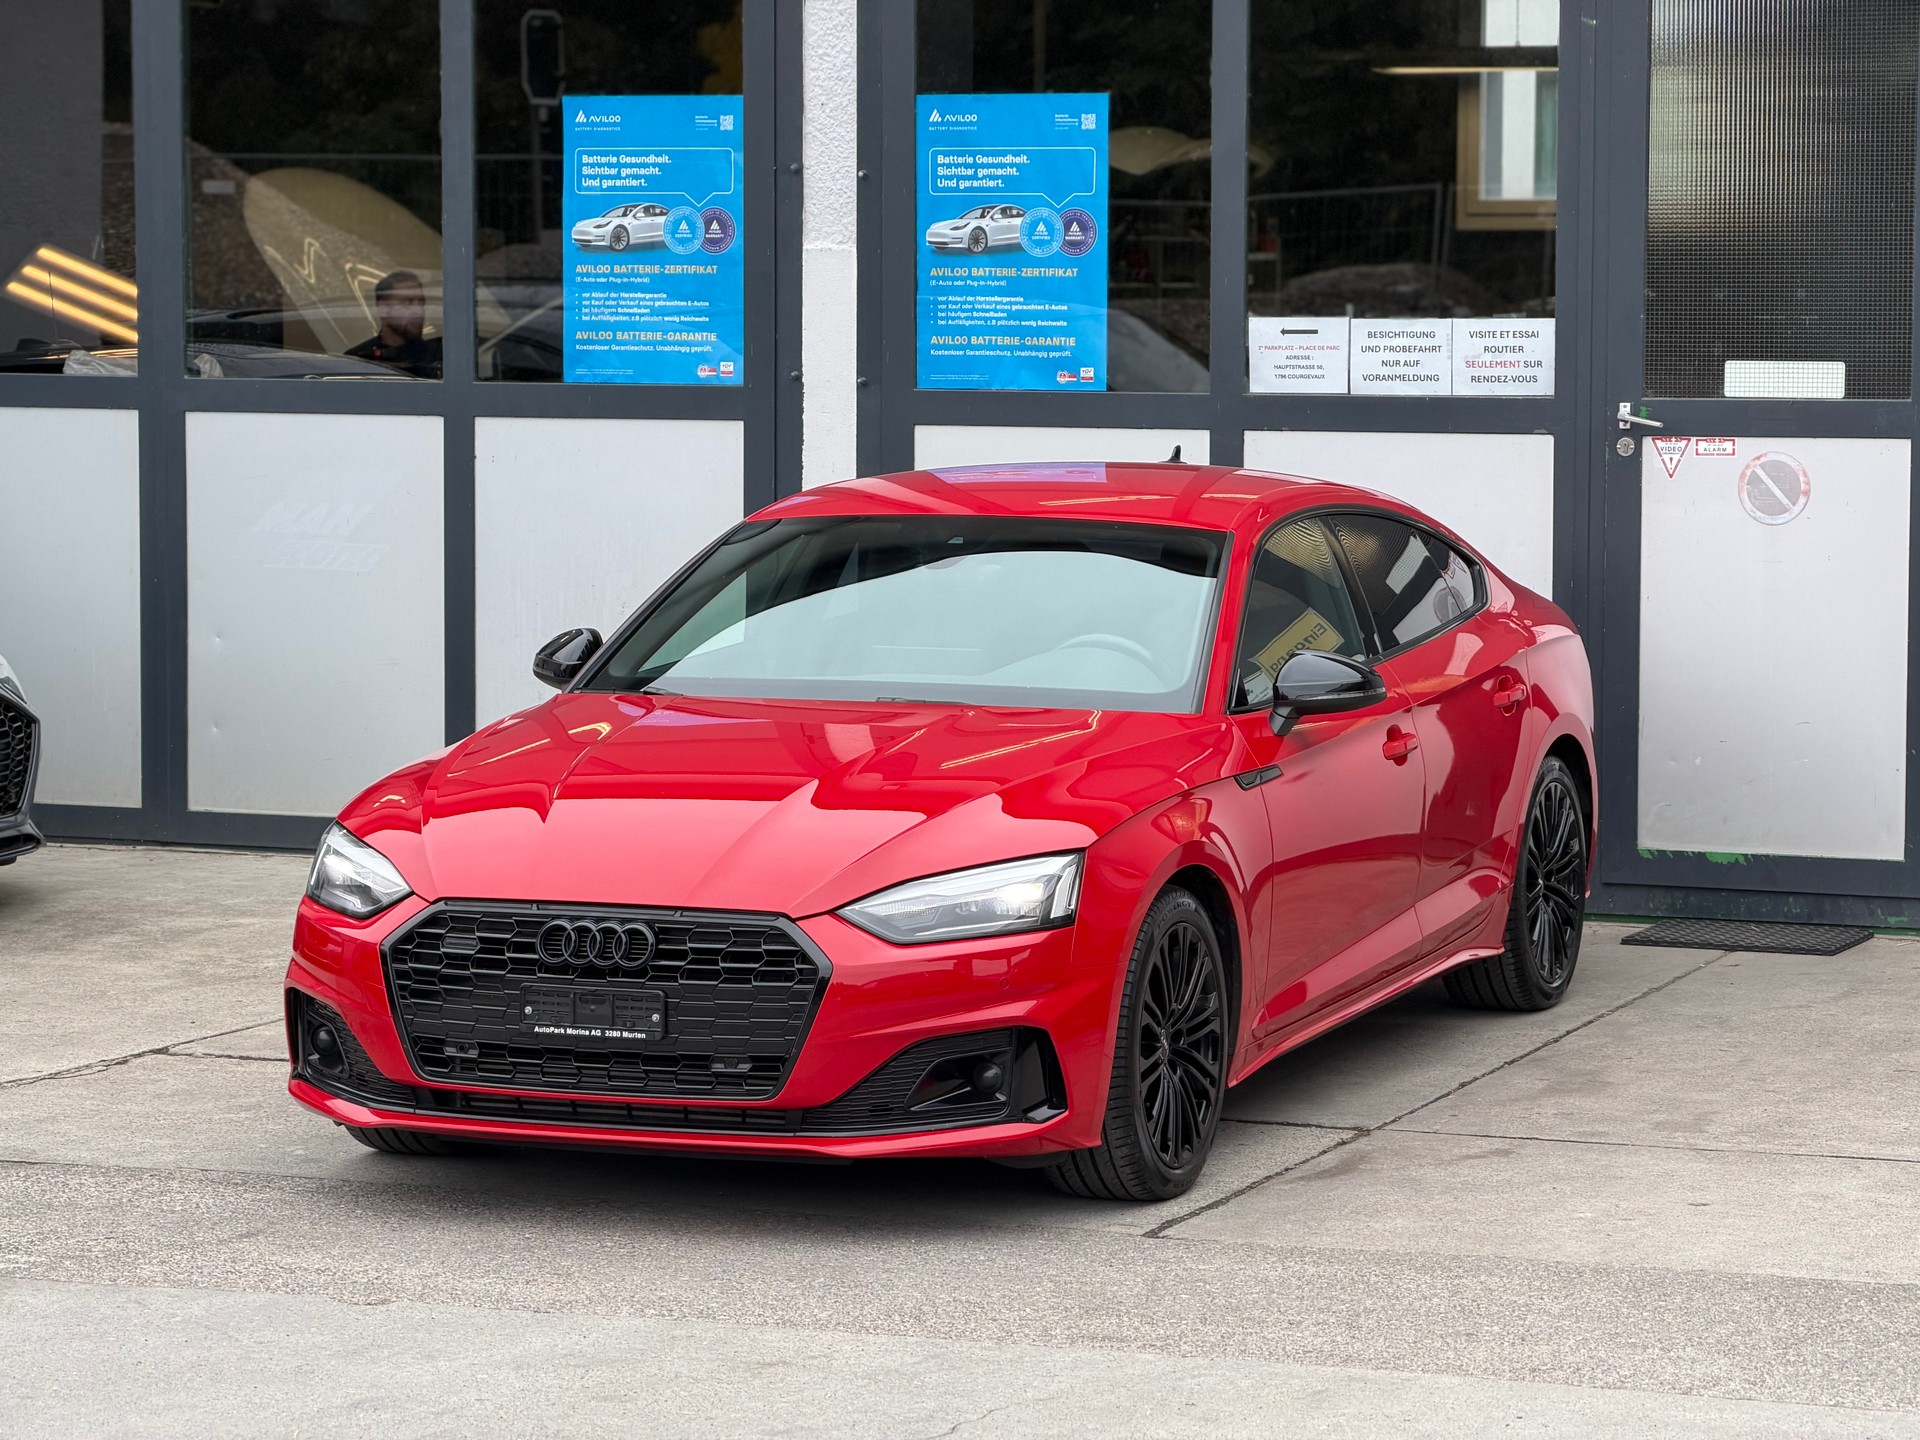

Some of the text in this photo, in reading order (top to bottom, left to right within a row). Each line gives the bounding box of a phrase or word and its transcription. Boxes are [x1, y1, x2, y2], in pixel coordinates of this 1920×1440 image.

[589, 115, 621, 123] AVILOO
[944, 114, 978, 122] AVILOO
[582, 154, 672, 164] Batterie Gesundheit.
[937, 154, 1030, 164] Batterie Gesundheit.
[582, 165, 662, 177] Sichtbar gemacht.
[937, 166, 1020, 178] Sichtbar gemacht.
[582, 177, 648, 189] Und garantiert.
[937, 178, 1005, 190] Und garantiert.
[576, 264, 718, 275] AVILOO BATTERIE-ZERTIFIKAT
[930, 267, 1078, 278] AVILOO BATTERIE-ZERTIFIKAT
[576, 331, 717, 342] AVILOO BATTERIE-GARANTIE
[1367, 330, 1436, 339] BESICHTIGUNG
[1468, 330, 1540, 339] VISITE ET ESSAI
[930, 335, 1076, 346] AVILOO BATTERIE-GARANTIE
[611, 344, 655, 352] Garantieschutz.
[656, 345, 690, 353] Unabhängig
[690, 345, 713, 353] geprüft.
[1360, 345, 1443, 354] UND PROBEFAHRT
[1483, 345, 1525, 354] ROUTIER
[965, 349, 1012, 357] Garantieschutz.
[1013, 350, 1048, 358] Unabhängig
[1048, 350, 1072, 358] geprüft.
[1381, 359, 1421, 368] NUR AUF
[1465, 360, 1543, 369] SEULEMENT SUR
[1361, 373, 1440, 382] VORANMELDUNG
[1470, 374, 1538, 383] RENDEZ-VOUS
[534, 1025, 565, 1034] AutoPark
[566, 1027, 590, 1036] Morina
[622, 1031, 646, 1039] Murten
